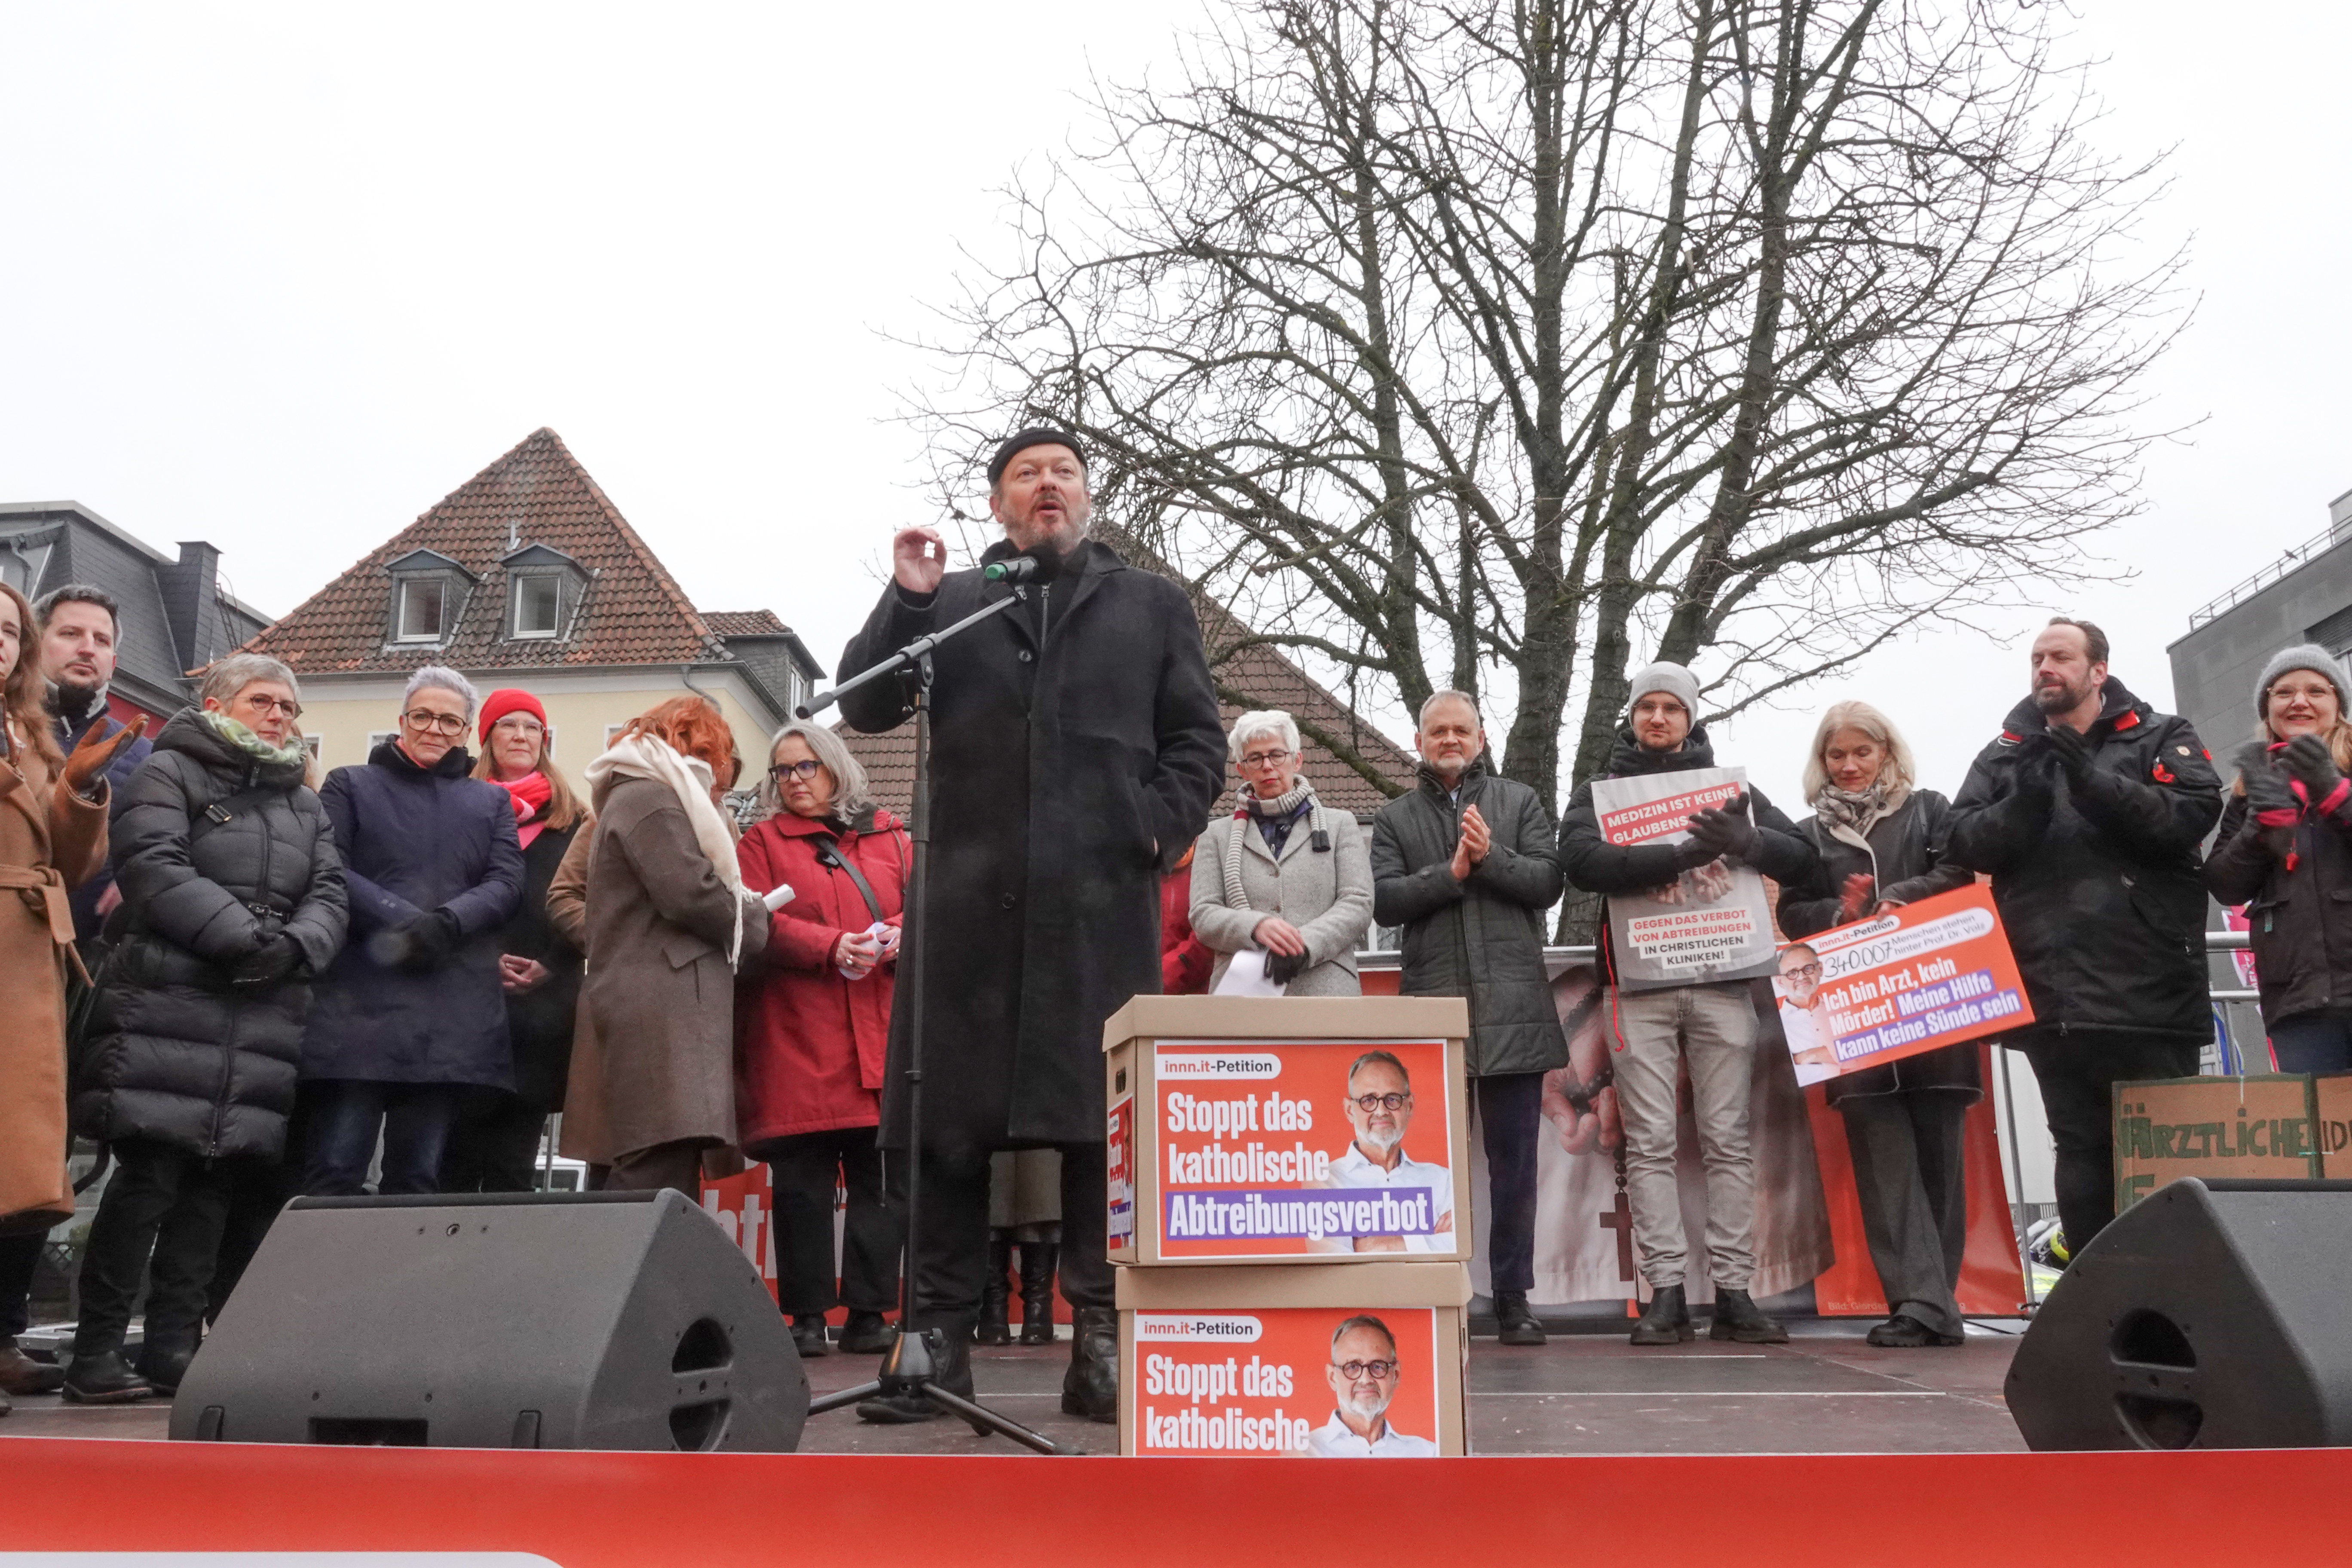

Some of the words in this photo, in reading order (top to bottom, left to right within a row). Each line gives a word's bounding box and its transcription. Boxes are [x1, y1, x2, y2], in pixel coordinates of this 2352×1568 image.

[1607, 802, 1668, 828] MEDIZIN
[1669, 796, 1691, 811] IST
[1694, 787, 1736, 805] KEINE
[1613, 810, 1709, 844] GLAUBENS
[1634, 918, 1672, 930] GEGEN
[1675, 915, 1698, 925] DAS
[1701, 910, 1746, 922] VERBOT
[1634, 933, 1659, 943] VON
[1662, 922, 1751, 939] ABTREIBUNGEN
[1818, 920, 1894, 949] innn.it-Petition
[1891, 925, 1941, 945] Menschen
[1942, 915, 1975, 930] stehen
[1660, 936, 1743, 952] CHRISTLICHEN
[1667, 951, 1724, 965] KLINIKEN!
[1894, 942, 1922, 955] hinter
[1924, 934, 1946, 946] Prof.
[1948, 930, 1961, 939] Dr.
[1822, 988, 1851, 1011] Ich
[1849, 981, 1878, 1003] bin
[1878, 968, 1919, 996] Arzt,
[1917, 957, 1957, 984] kein
[1828, 998, 1895, 1036] Mörder!
[1897, 988, 1951, 1017] Meine
[1948, 972, 1992, 1001] Hilfe
[1835, 1034, 1879, 1060] kann
[1877, 1020, 1926, 1048] keine
[1925, 1002, 1981, 1035] Sünde
[1981, 991, 2020, 1019] sein
[1164, 1060, 1272, 1073] innn.it-Petition
[1167, 1092, 1259, 1139] Stoppt
[1263, 1091, 1312, 1131] das
[2119, 1102, 2309, 1159] ÄRZTLICHE
[1169, 1142, 1329, 1184] katholische
[1169, 1191, 1429, 1241] Abtreibungsverbot
[1144, 1321, 1253, 1335] innn.it-Petition
[1146, 1354, 1237, 1404] Stoppt
[1243, 1355, 1293, 1397] das
[1146, 1406, 1310, 1451] katholische
